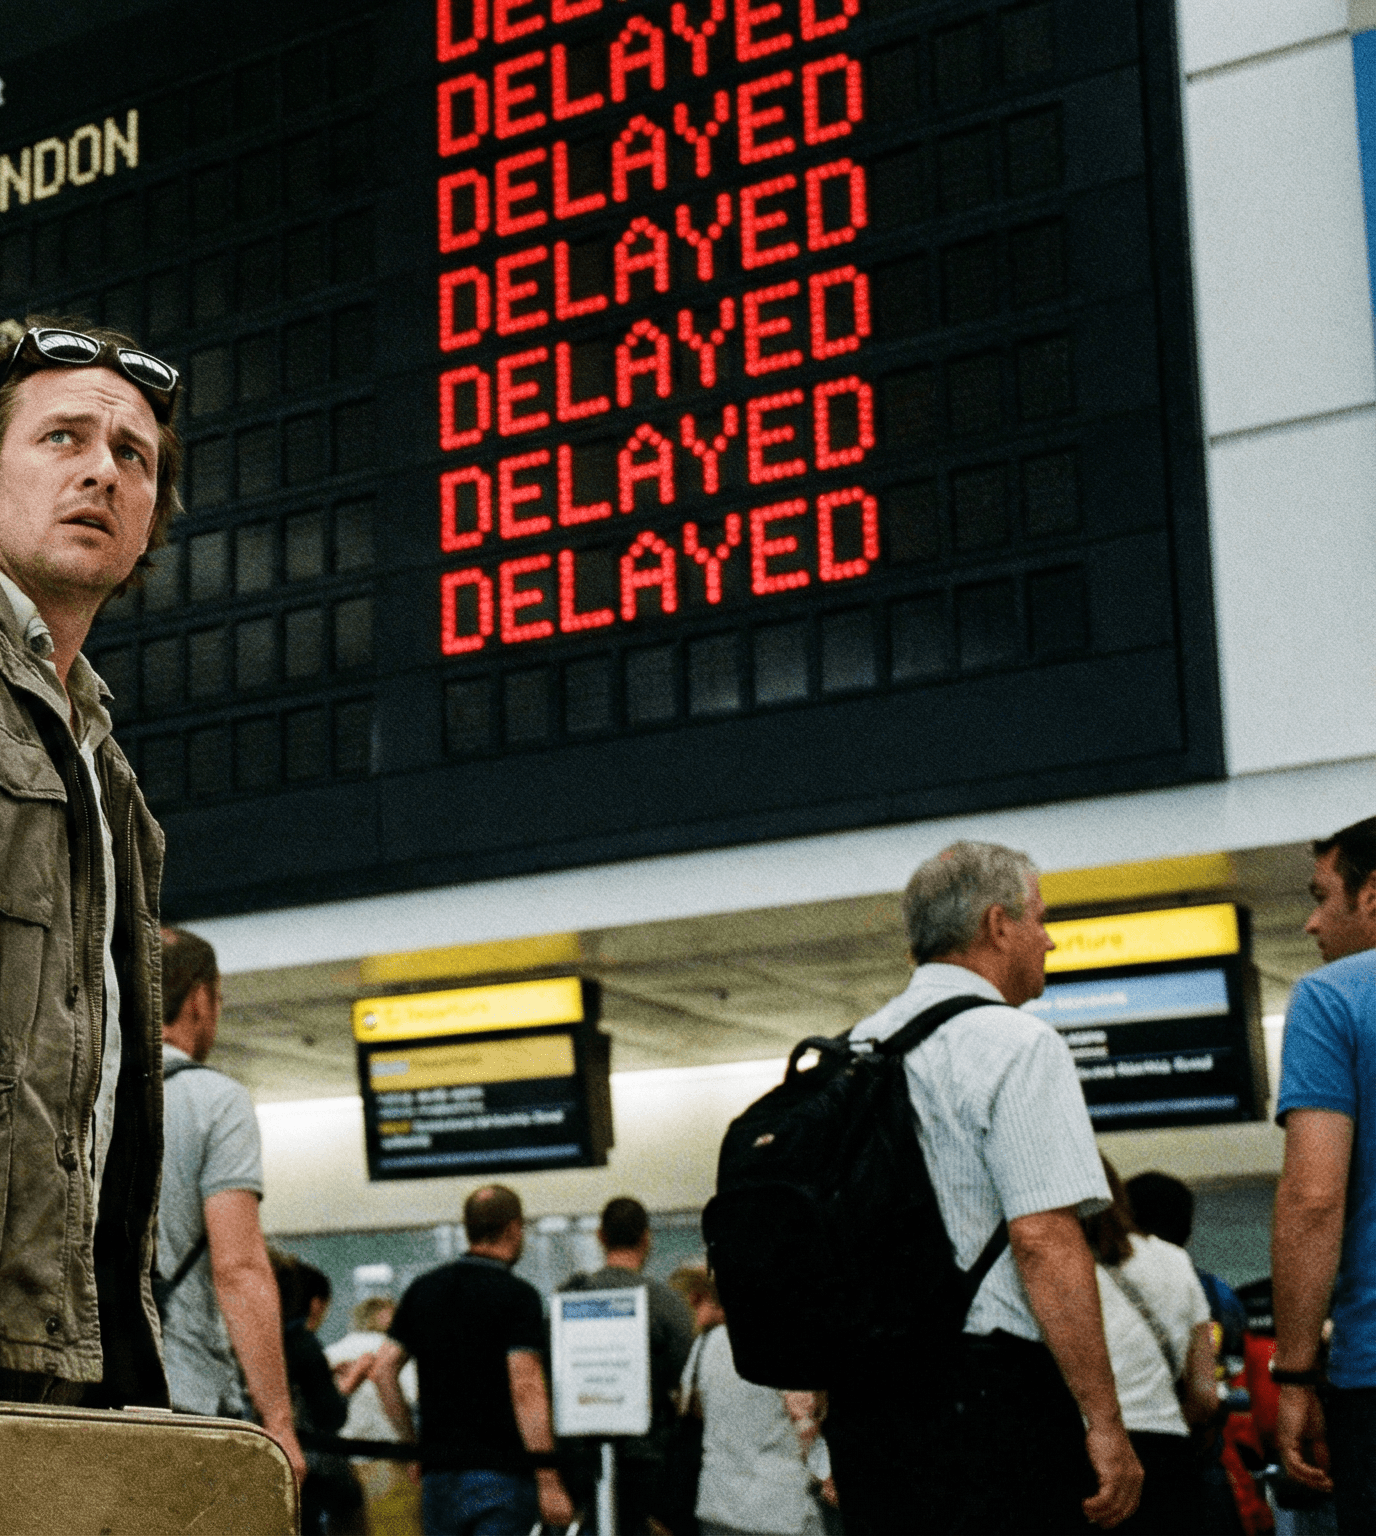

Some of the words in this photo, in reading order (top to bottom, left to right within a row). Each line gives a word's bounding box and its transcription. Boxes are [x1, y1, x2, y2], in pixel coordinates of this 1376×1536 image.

[436, 53, 864, 254] DELAYED
[437, 158, 869, 353] DELAYED
[437, 264, 872, 453] DELAYED
[438, 375, 877, 553] DELAYED
[439, 486, 881, 656] DELAYED
